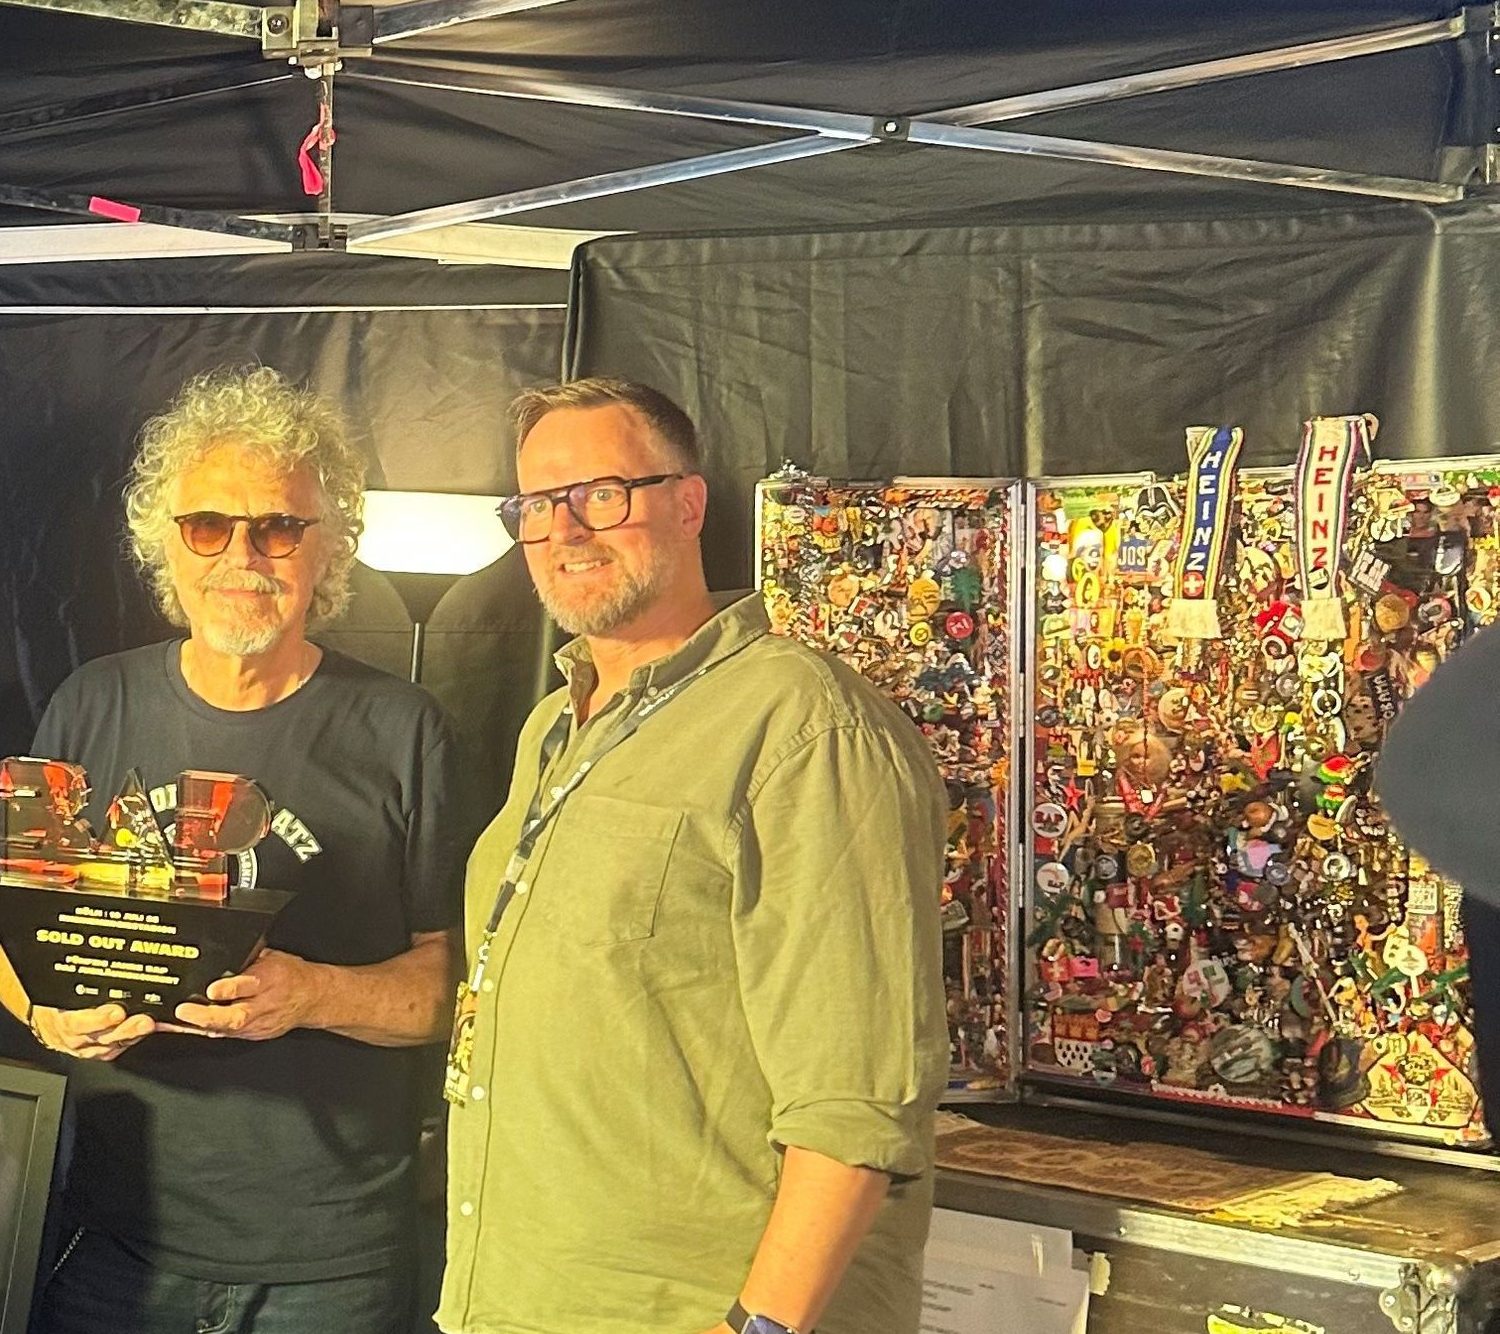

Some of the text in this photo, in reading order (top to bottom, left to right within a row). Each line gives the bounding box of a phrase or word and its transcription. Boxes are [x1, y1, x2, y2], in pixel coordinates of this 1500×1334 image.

[1186, 451, 1222, 571] HEINZ
[1311, 445, 1338, 569] HEINZ
[36, 929, 200, 959] SOLD OUT AWARD
